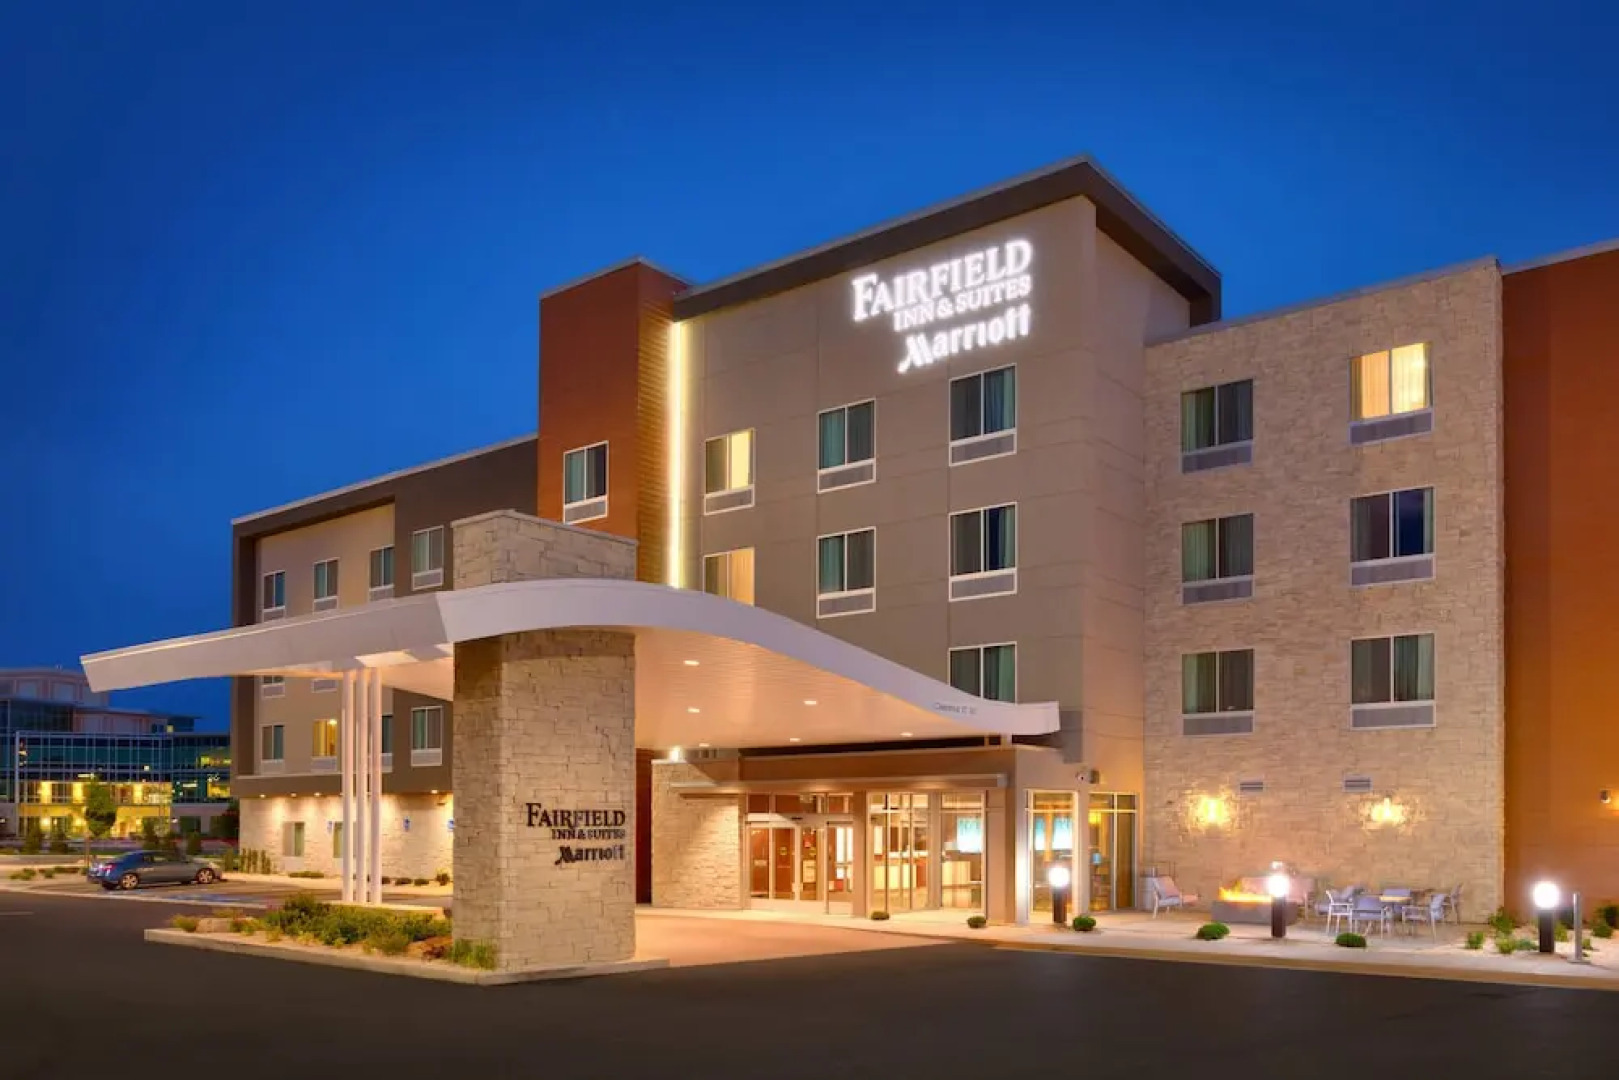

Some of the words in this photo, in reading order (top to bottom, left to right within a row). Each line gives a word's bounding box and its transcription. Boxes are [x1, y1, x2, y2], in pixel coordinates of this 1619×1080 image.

[853, 239, 1032, 322] FAIRFIELD
[894, 301, 935, 332] INN
[937, 298, 954, 319] &
[956, 274, 1032, 314] SUITES
[897, 303, 1031, 374] Marriott
[526, 803, 626, 828] FAIRFIELD
[552, 829, 576, 840] INN
[587, 829, 626, 840] SUITES
[554, 845, 624, 866] Marriott
